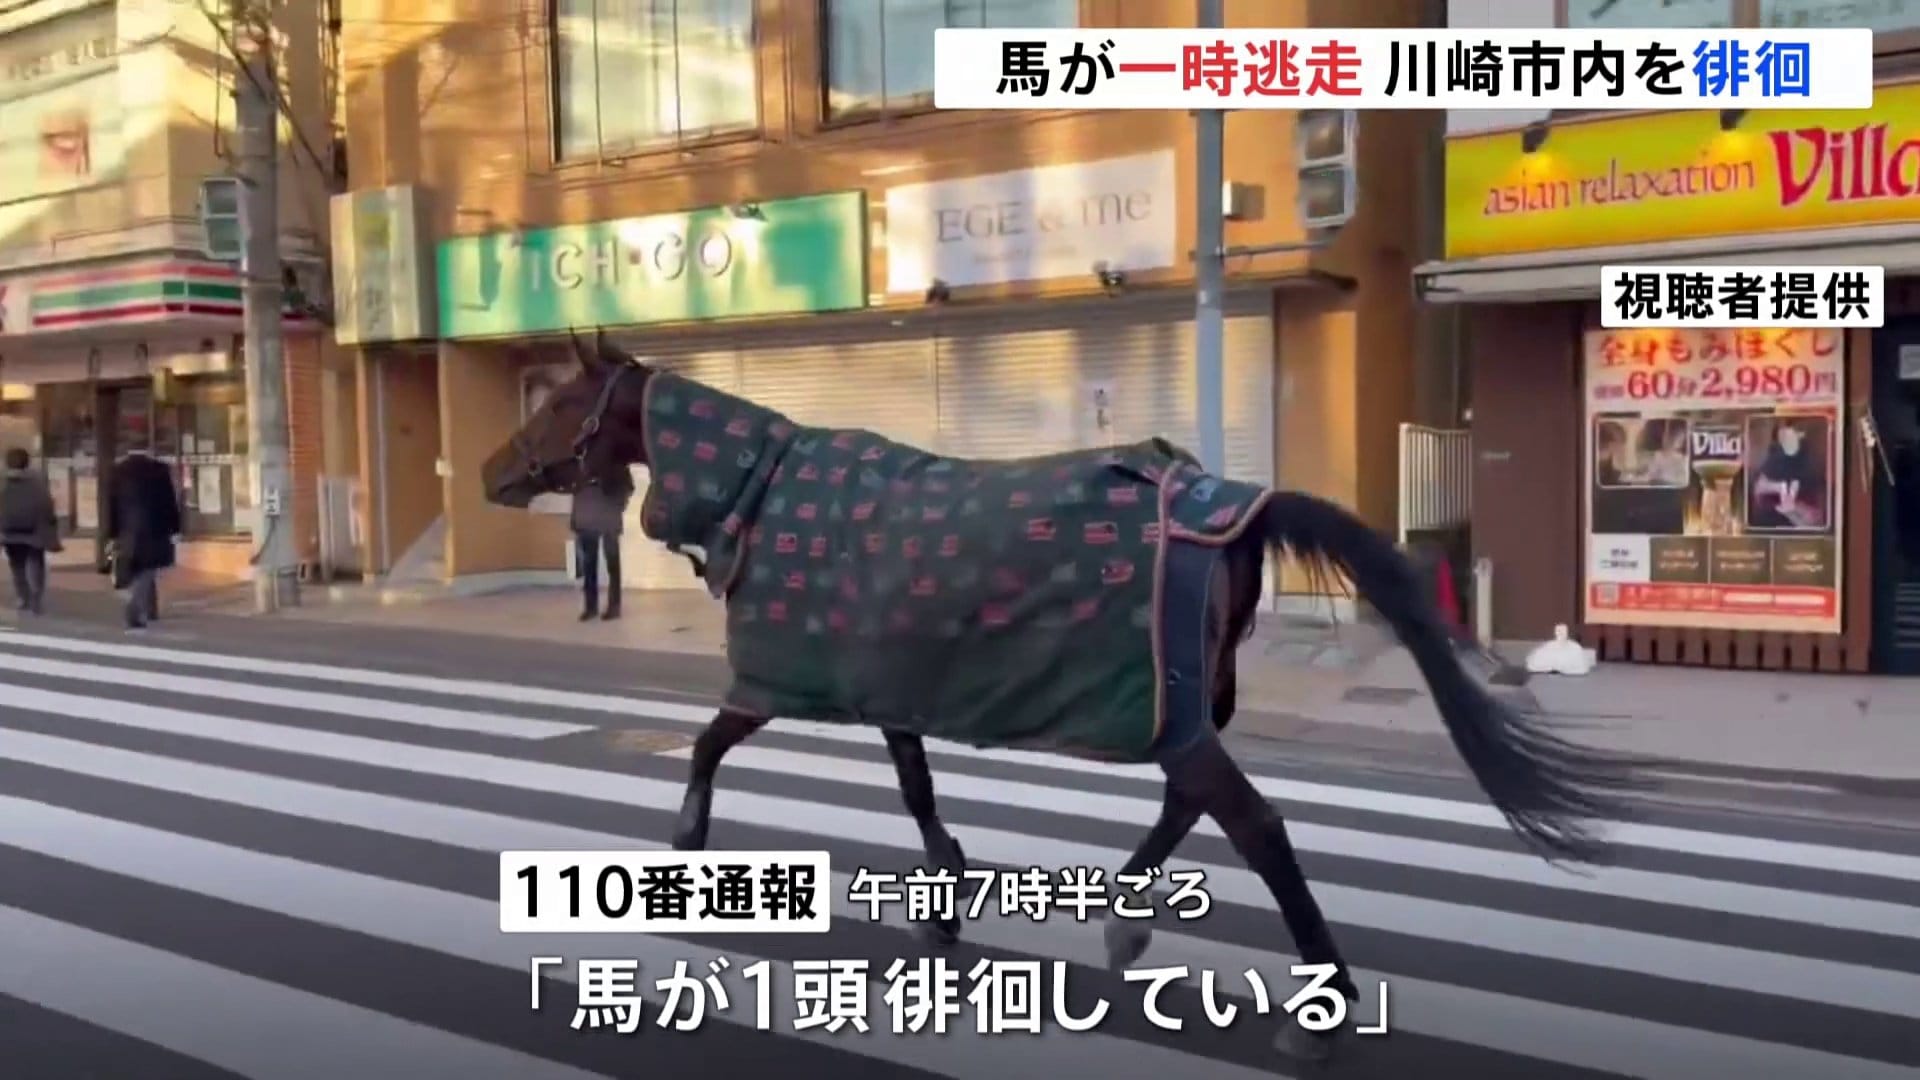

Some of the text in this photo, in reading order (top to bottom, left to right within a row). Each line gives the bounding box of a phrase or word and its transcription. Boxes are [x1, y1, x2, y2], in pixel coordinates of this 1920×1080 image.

[1483, 168, 1570, 216] asian
[1579, 157, 1756, 205] relaxation
[935, 202, 1026, 243] EGE
[1080, 191, 1152, 227] me
[1692, 431, 1741, 456] Villa
